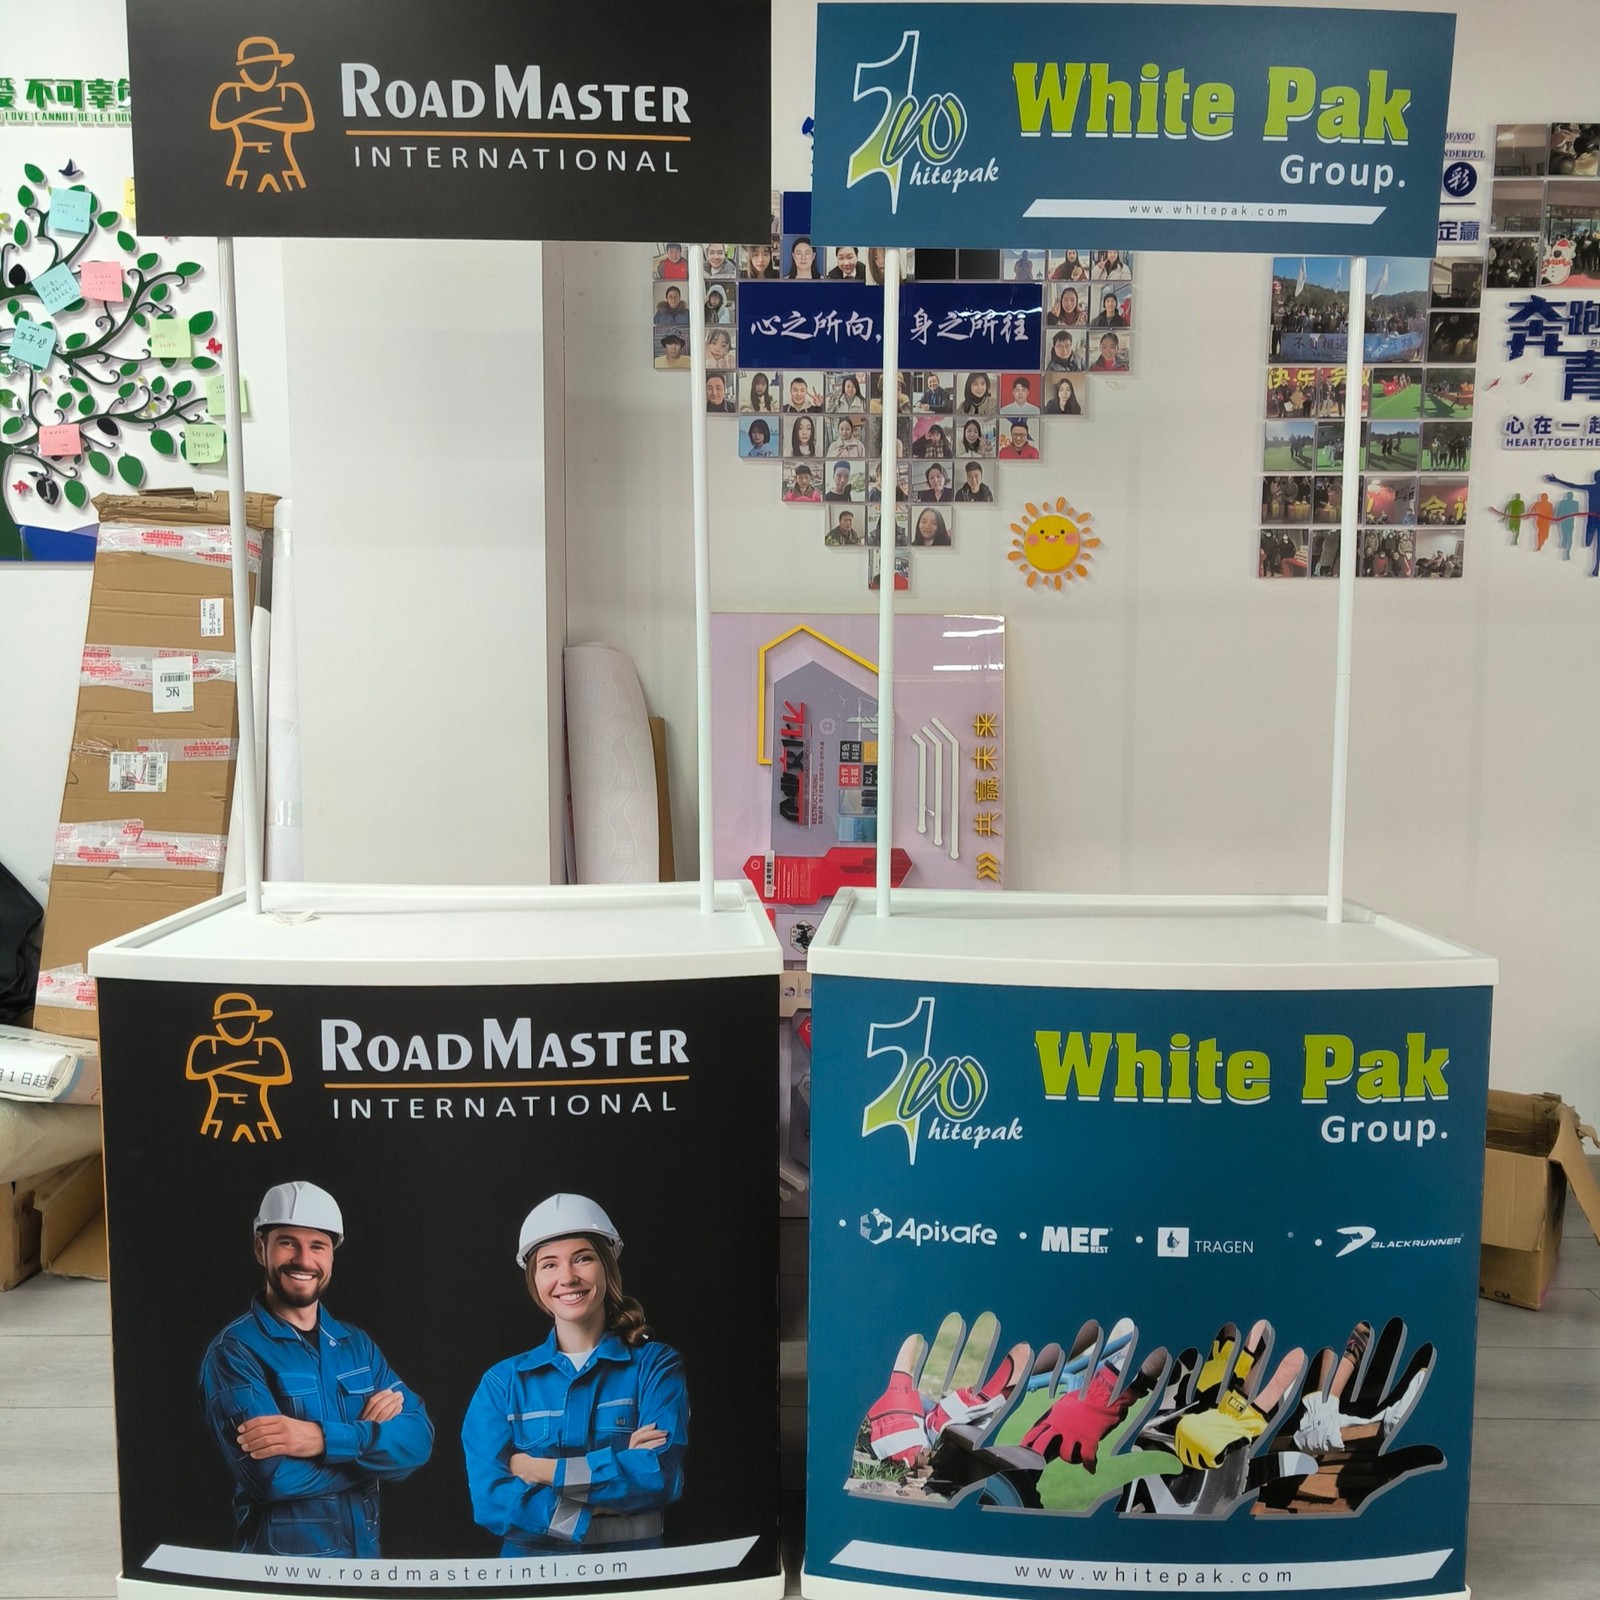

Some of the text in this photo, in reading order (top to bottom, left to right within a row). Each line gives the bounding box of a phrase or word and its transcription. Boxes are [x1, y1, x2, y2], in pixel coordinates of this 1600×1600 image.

[35, 112, 75, 121] CANNOT
[94, 113, 112, 122] LET
[1012, 62, 1412, 146] White Pak
[354, 146, 678, 173] INTERNATIONAL
[1280, 154, 1406, 194] Group.
[1447, 167, 1471, 192] 彩
[1128, 204, 1289, 217] www.whitepak.com
[910, 306, 1029, 345] 身之所往
[1506, 438, 1544, 447] HEART
[973, 713, 1001, 837] 共赢未来
[1033, 1030, 1450, 1105] White Pak
[333, 1091, 677, 1119] INTERNATIONAL
[1320, 1114, 1449, 1147] Group.
[895, 1217, 998, 1247] Apisafe
[1370, 1236, 1462, 1249] BLACKRUNNER
[1193, 1239, 1254, 1254] TRAGEN
[264, 1560, 629, 1582] www.roadmasterintl.com
[1014, 1564, 1293, 1587] www.whitepak.com
